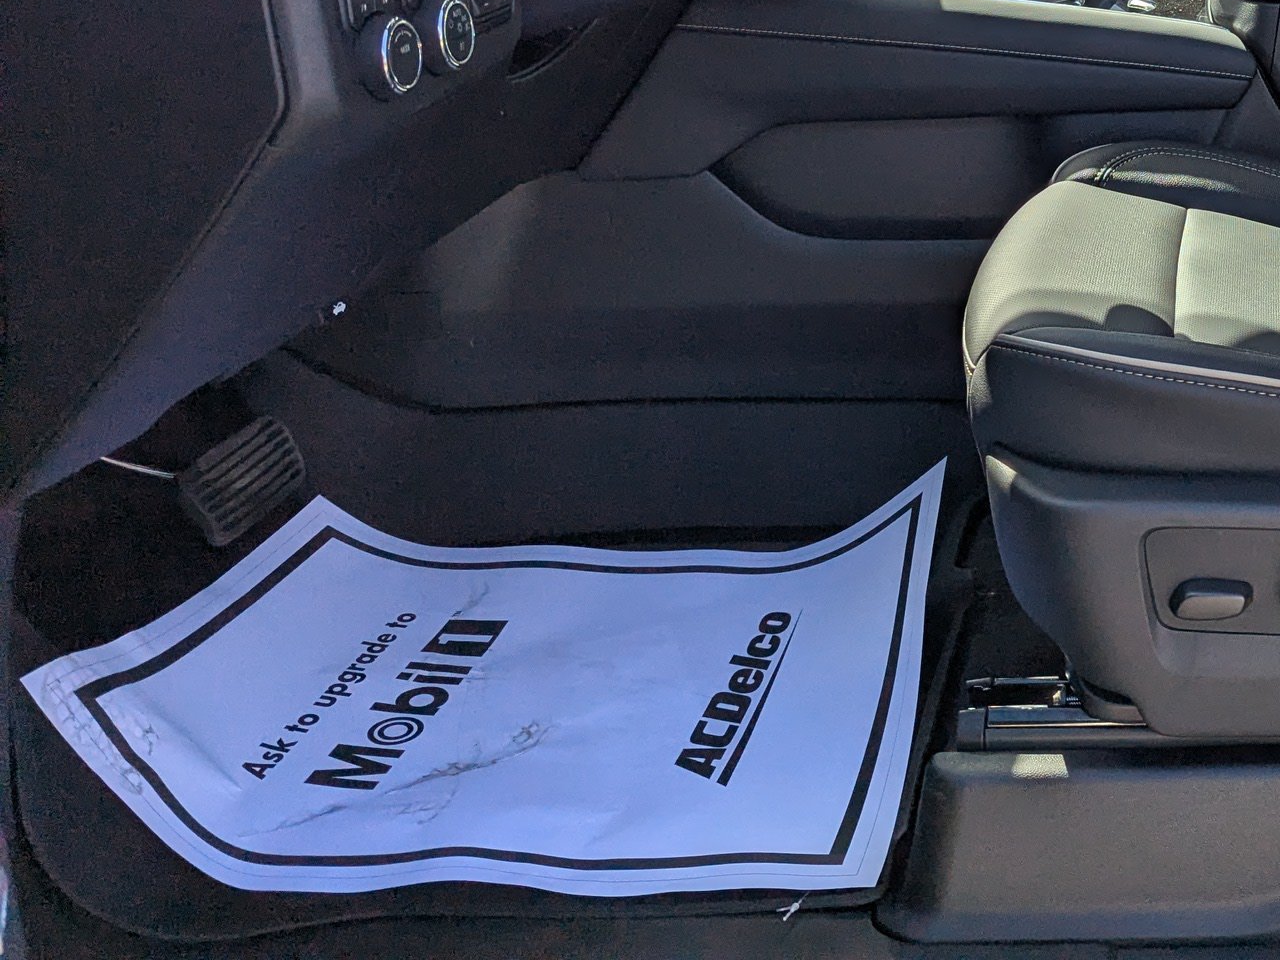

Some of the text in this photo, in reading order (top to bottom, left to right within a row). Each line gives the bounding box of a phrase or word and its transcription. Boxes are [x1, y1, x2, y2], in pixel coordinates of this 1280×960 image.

[242, 611, 418, 781] Ask to upgrade to
[304, 618, 509, 792] Mobil 1
[674, 610, 794, 784] ACDelco
